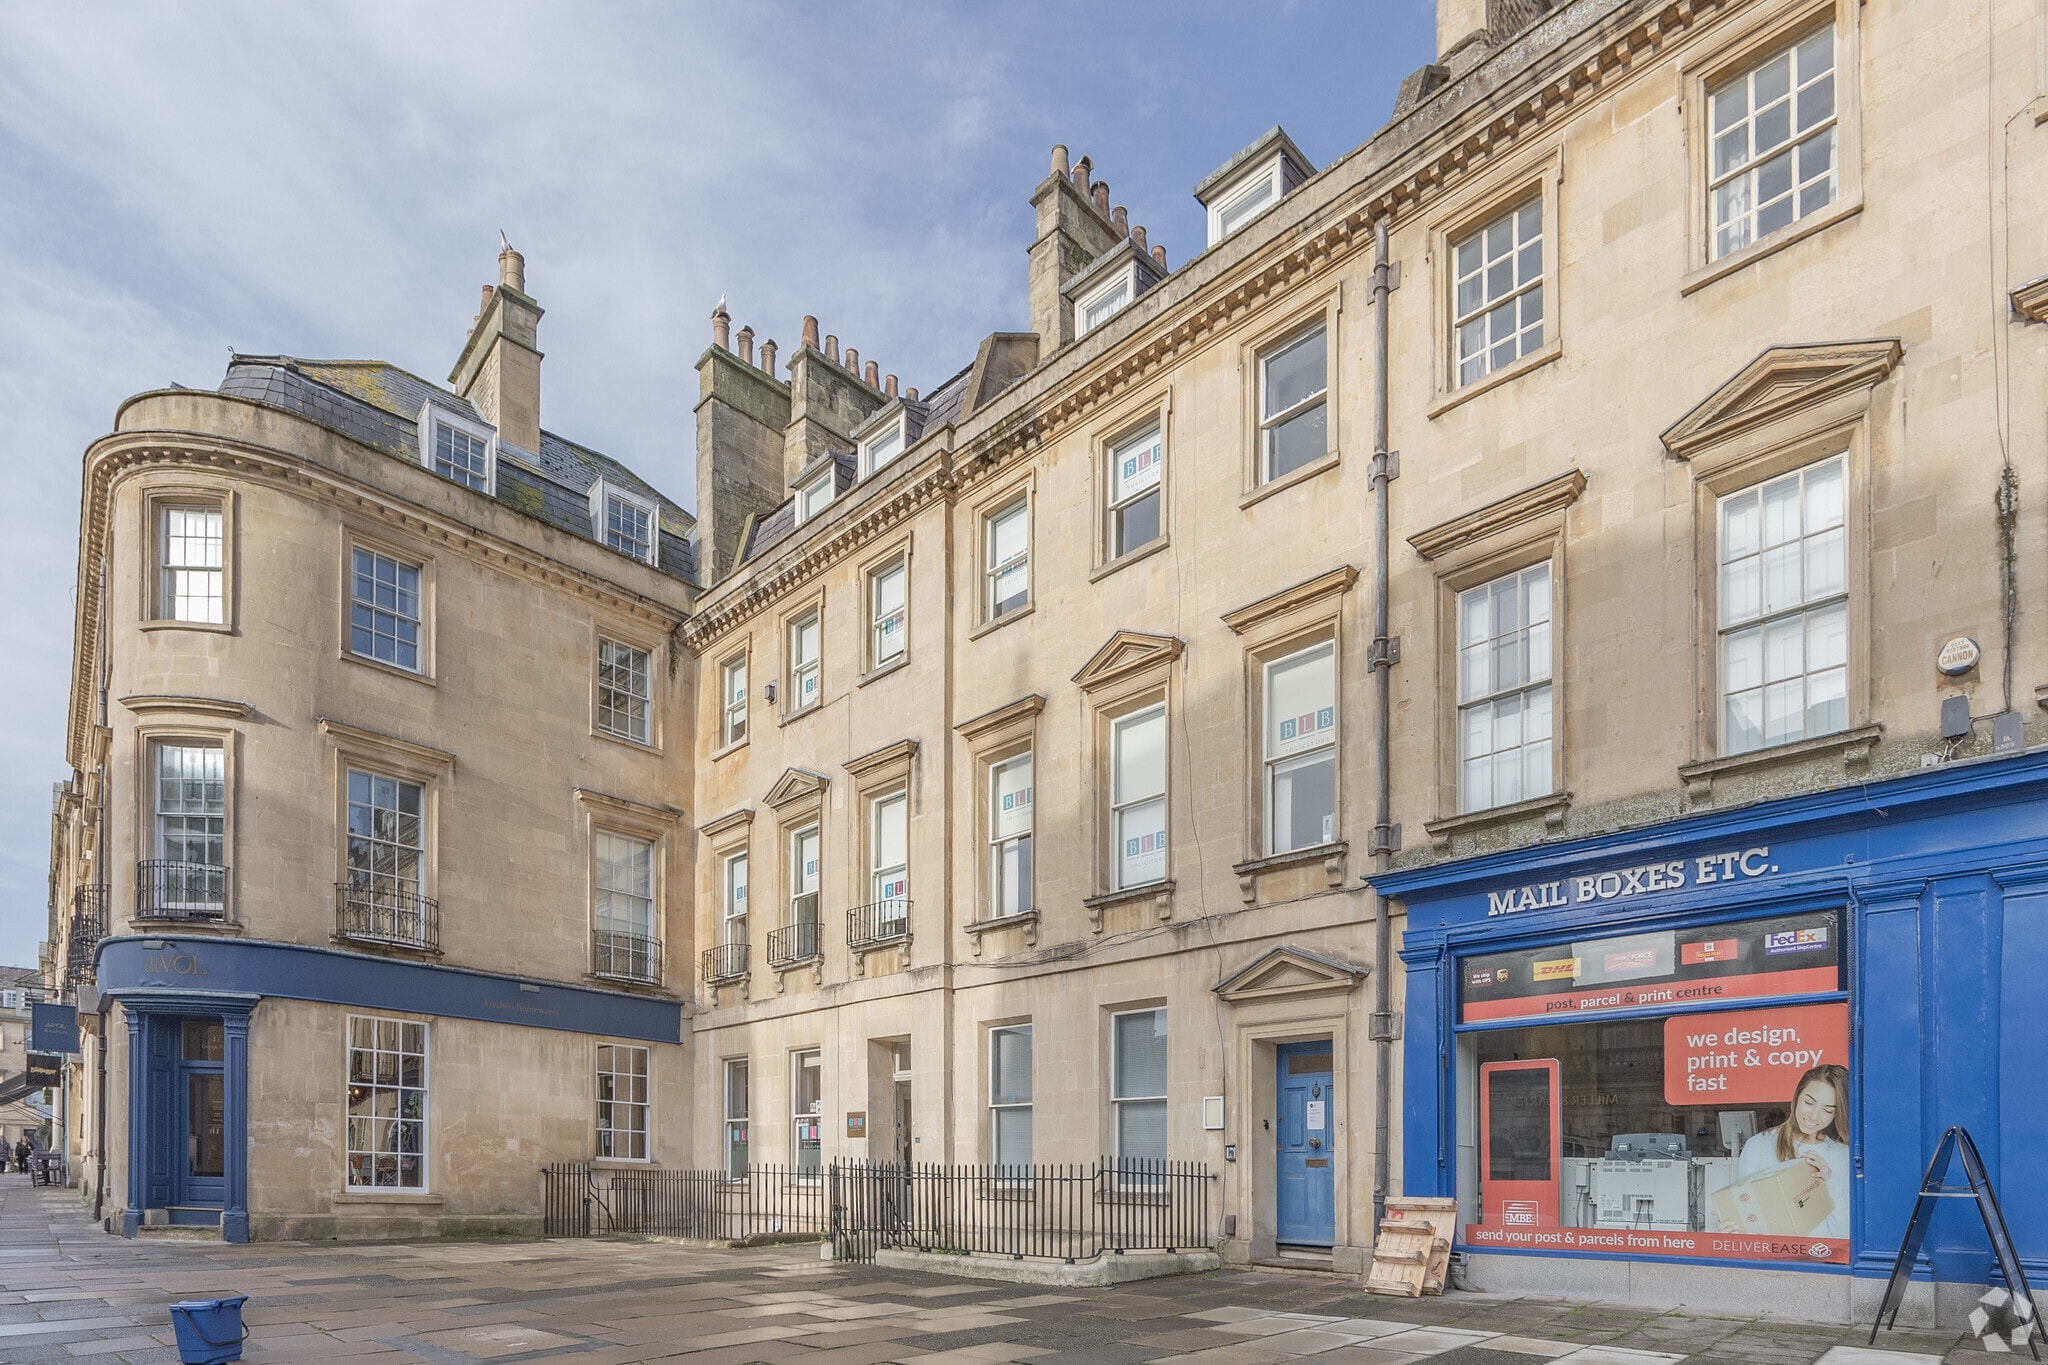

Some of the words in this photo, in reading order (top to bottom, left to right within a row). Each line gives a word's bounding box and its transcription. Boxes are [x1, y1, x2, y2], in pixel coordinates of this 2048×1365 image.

[1942, 650, 1974, 665] CANNON
[1488, 881, 1568, 917] MAIL
[1576, 861, 1686, 903] BOXES
[1695, 846, 1779, 884] ETC.
[1770, 929, 1816, 946] FedEx
[1538, 963, 1575, 976] DHL
[1546, 998, 1577, 1012] post,
[1580, 993, 1620, 1009] parcel
[1624, 992, 1635, 1003] &
[1639, 987, 1672, 1006] print
[1676, 984, 1723, 999] centre
[1686, 1033, 1717, 1048] we
[1724, 1025, 1801, 1047] design,
[1687, 1051, 1738, 1073] print
[1743, 1048, 1761, 1067] &
[1767, 1049, 1824, 1068] copy
[1686, 1074, 1728, 1091] fast
[1508, 1213, 1533, 1223] MBE
[1476, 1229, 1503, 1241] send
[1505, 1231, 1533, 1244] your
[1535, 1230, 1562, 1244] post
[1565, 1232, 1575, 1244] &
[1579, 1232, 1624, 1247] parcels
[1627, 1233, 1660, 1247] from
[1663, 1234, 1695, 1249] here
[1713, 1239, 1807, 1255] DELIVEREASE
